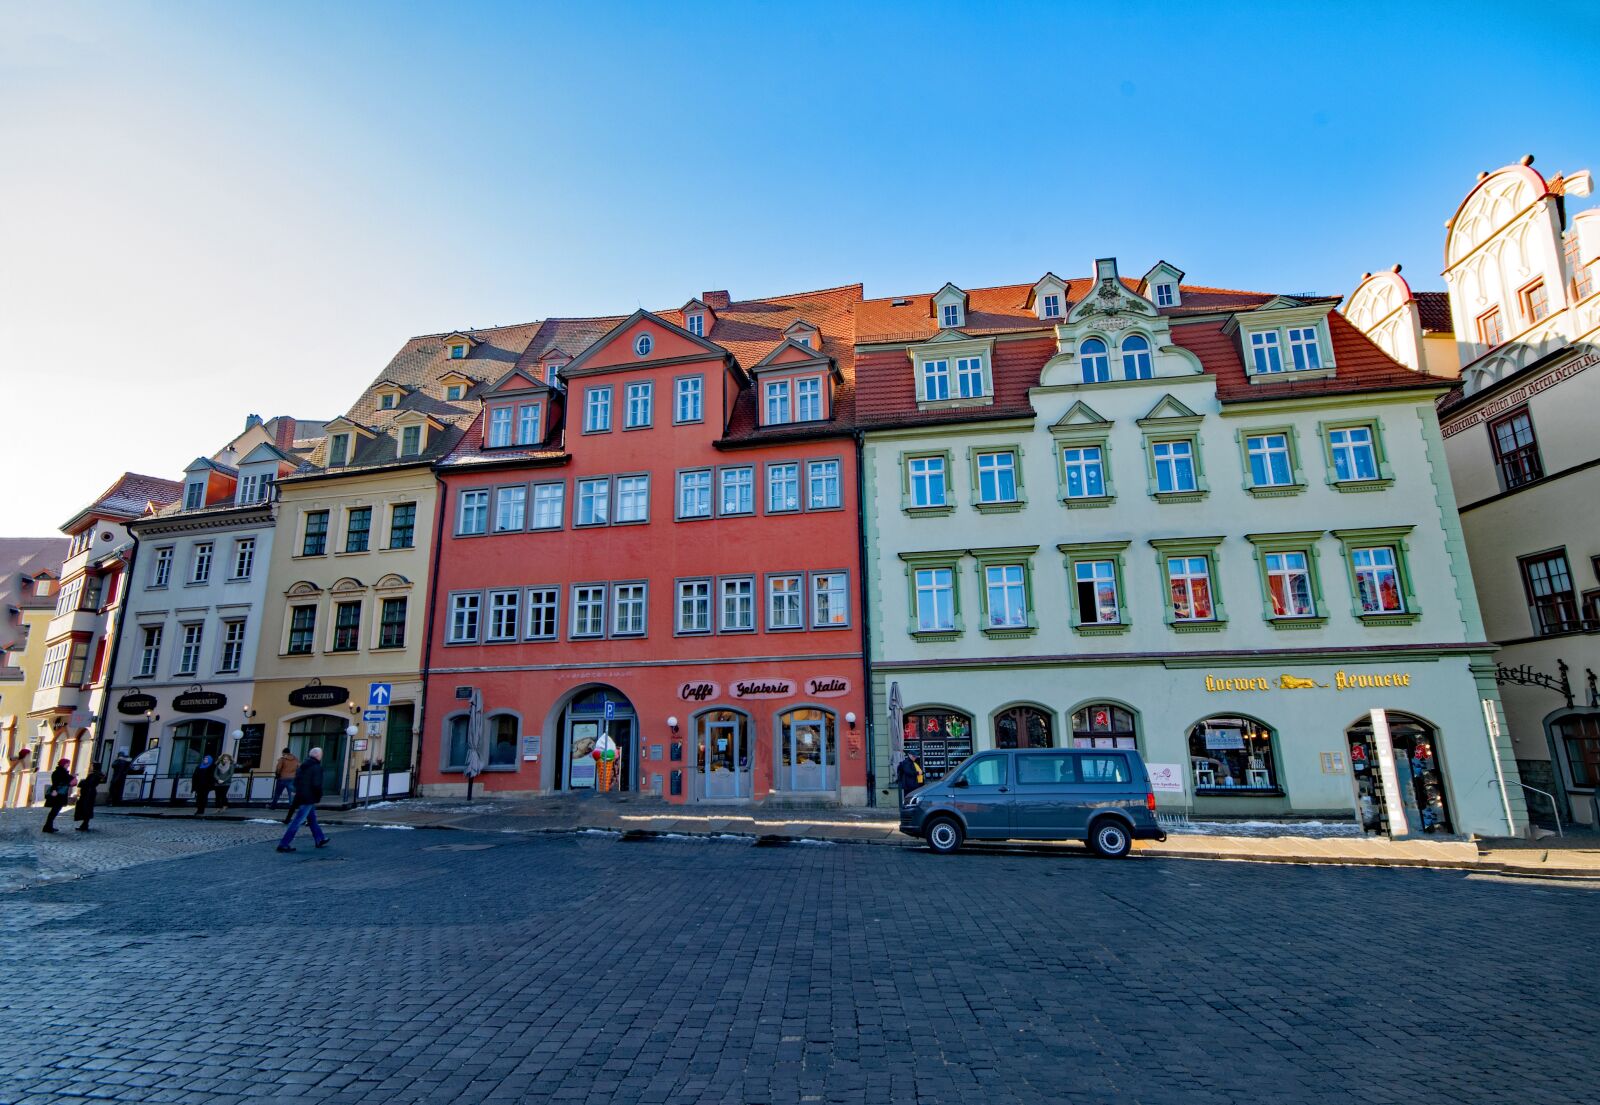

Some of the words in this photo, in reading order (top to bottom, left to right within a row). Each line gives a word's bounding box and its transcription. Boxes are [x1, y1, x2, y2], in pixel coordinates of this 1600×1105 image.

[1511, 388, 1527, 405] und
[737, 682, 789, 697] Gelateria
[810, 680, 847, 695] Italia
[1205, 674, 1269, 692] Loewen
[1334, 669, 1410, 691] Apotheke
[302, 692, 334, 700] PIZZERIA
